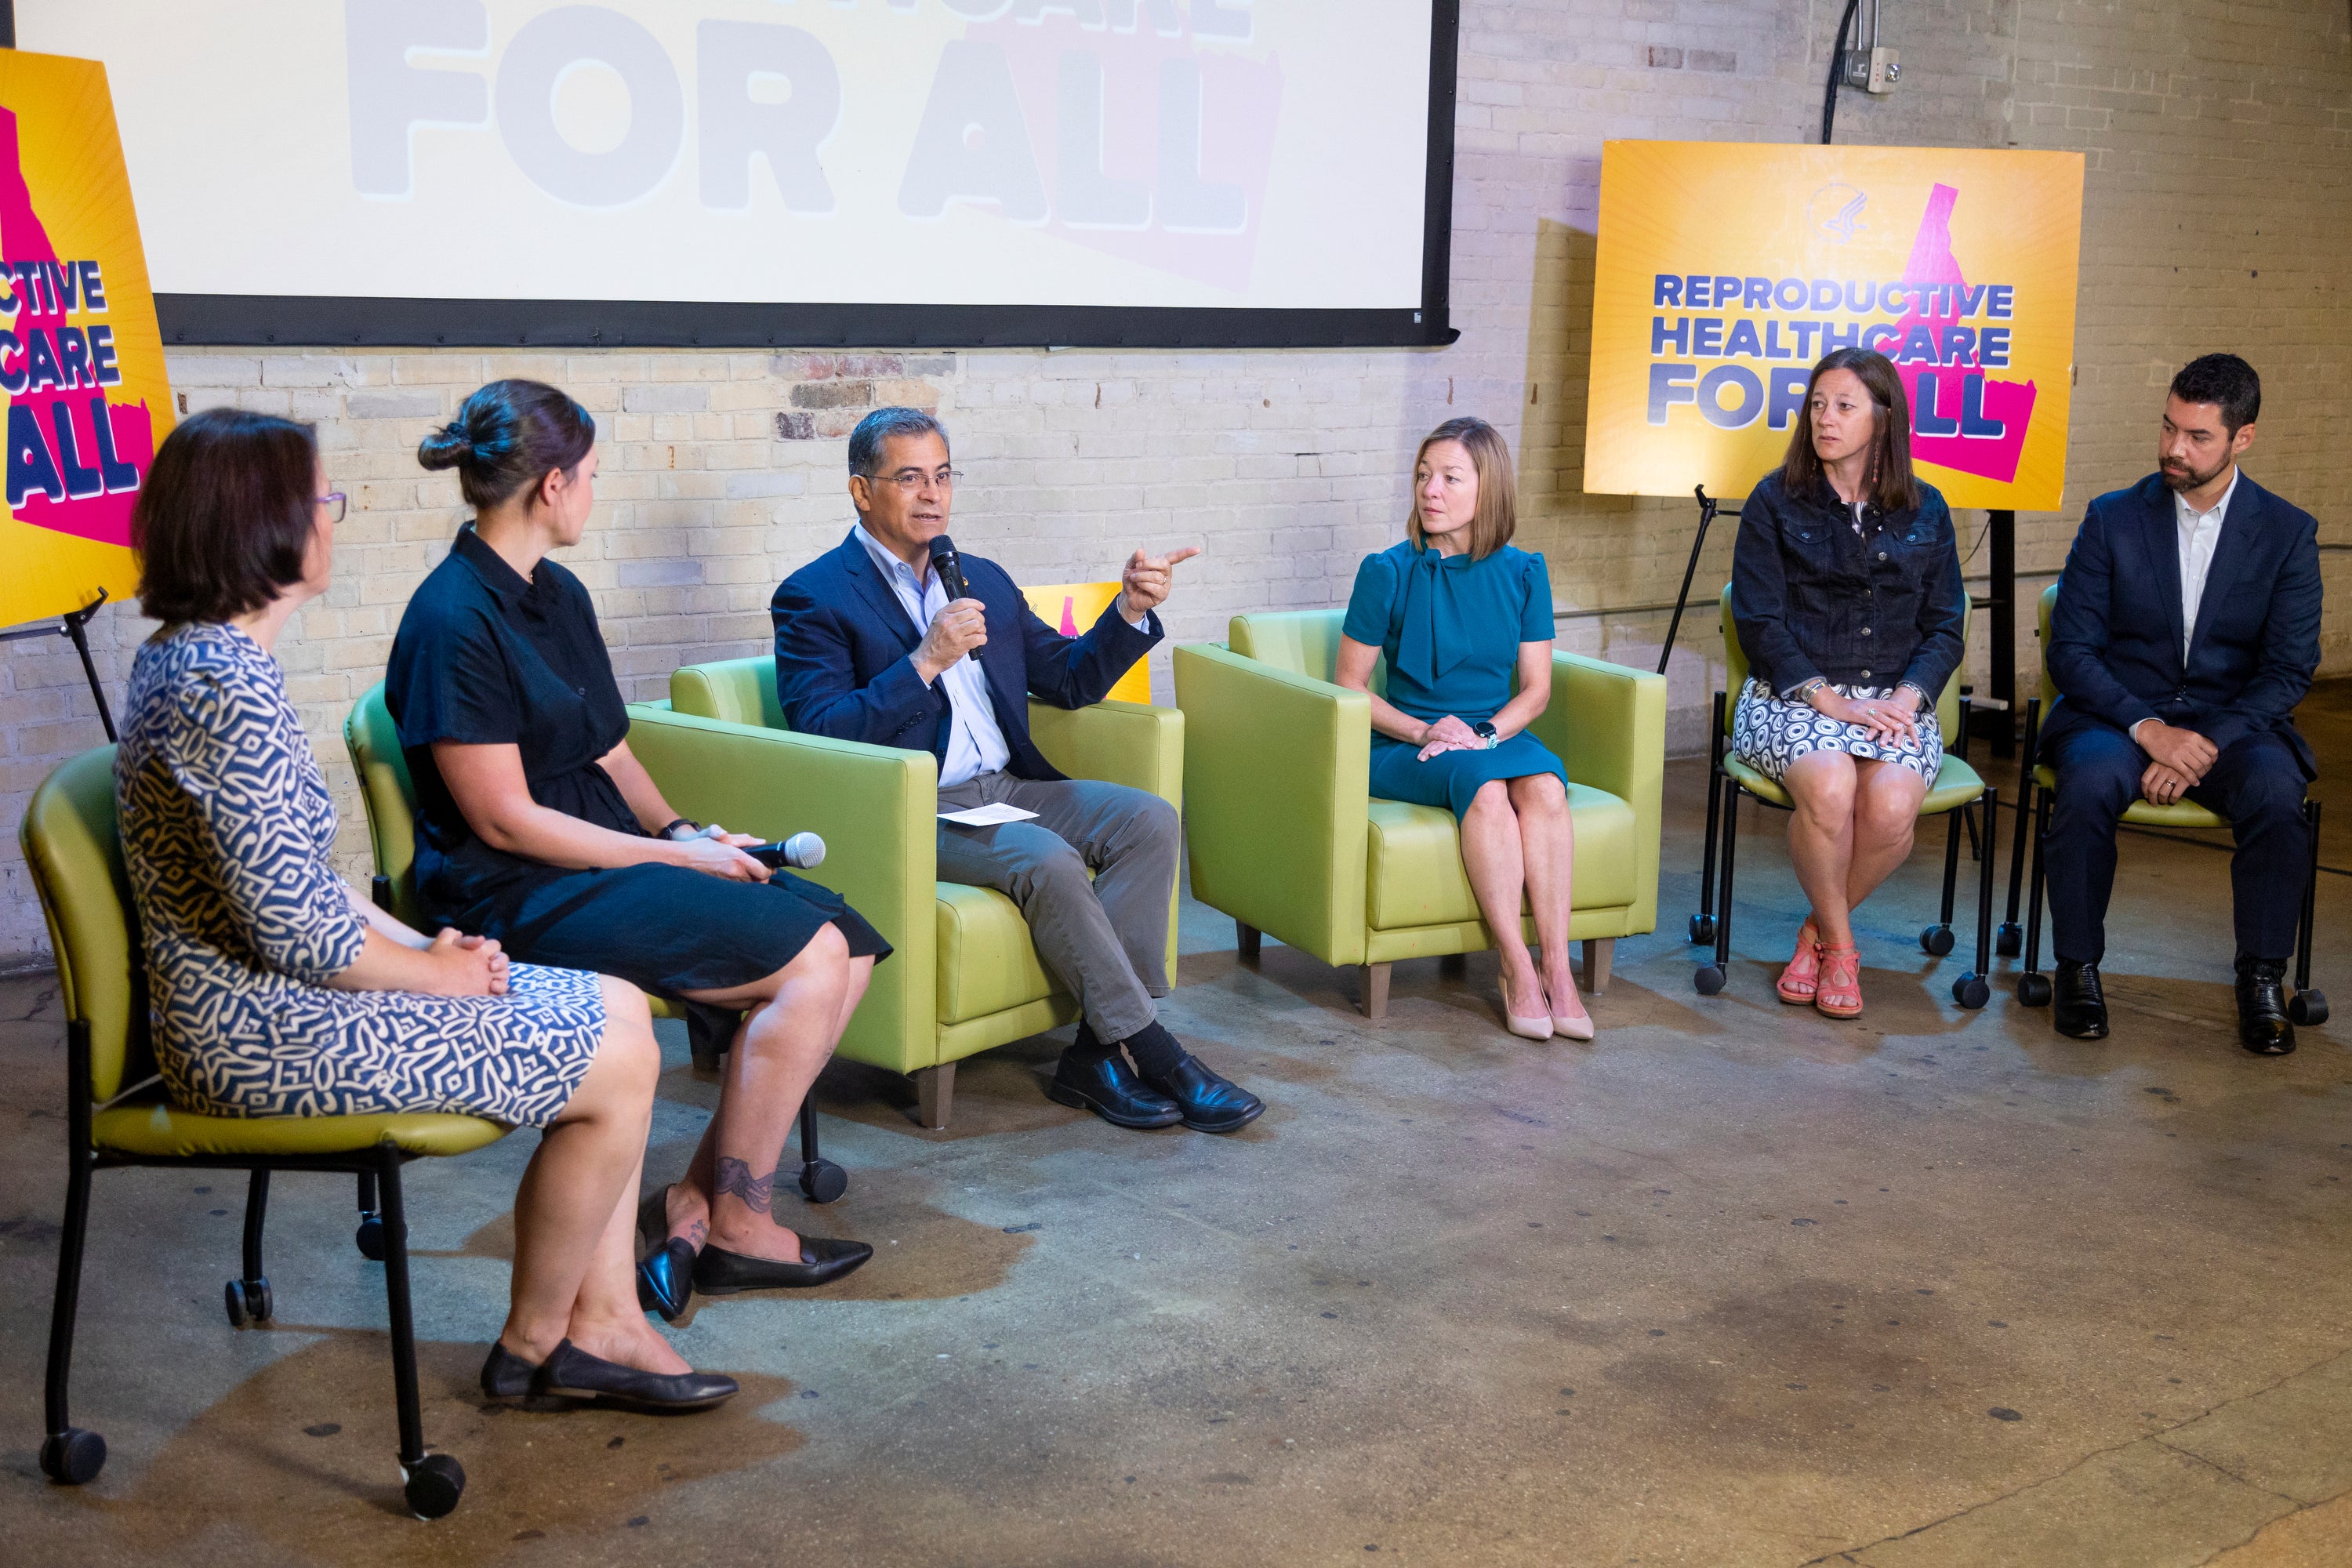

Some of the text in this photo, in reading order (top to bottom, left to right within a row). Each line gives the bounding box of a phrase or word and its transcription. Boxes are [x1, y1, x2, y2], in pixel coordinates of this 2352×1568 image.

[344, 0, 1248, 233] FOR ALL
[1653, 274, 2014, 319] REPRODUCTIVE
[1650, 316, 2012, 369] HEALTHCARE
[1647, 363, 2005, 440] FOR LL
[5, 397, 141, 510] ALL
